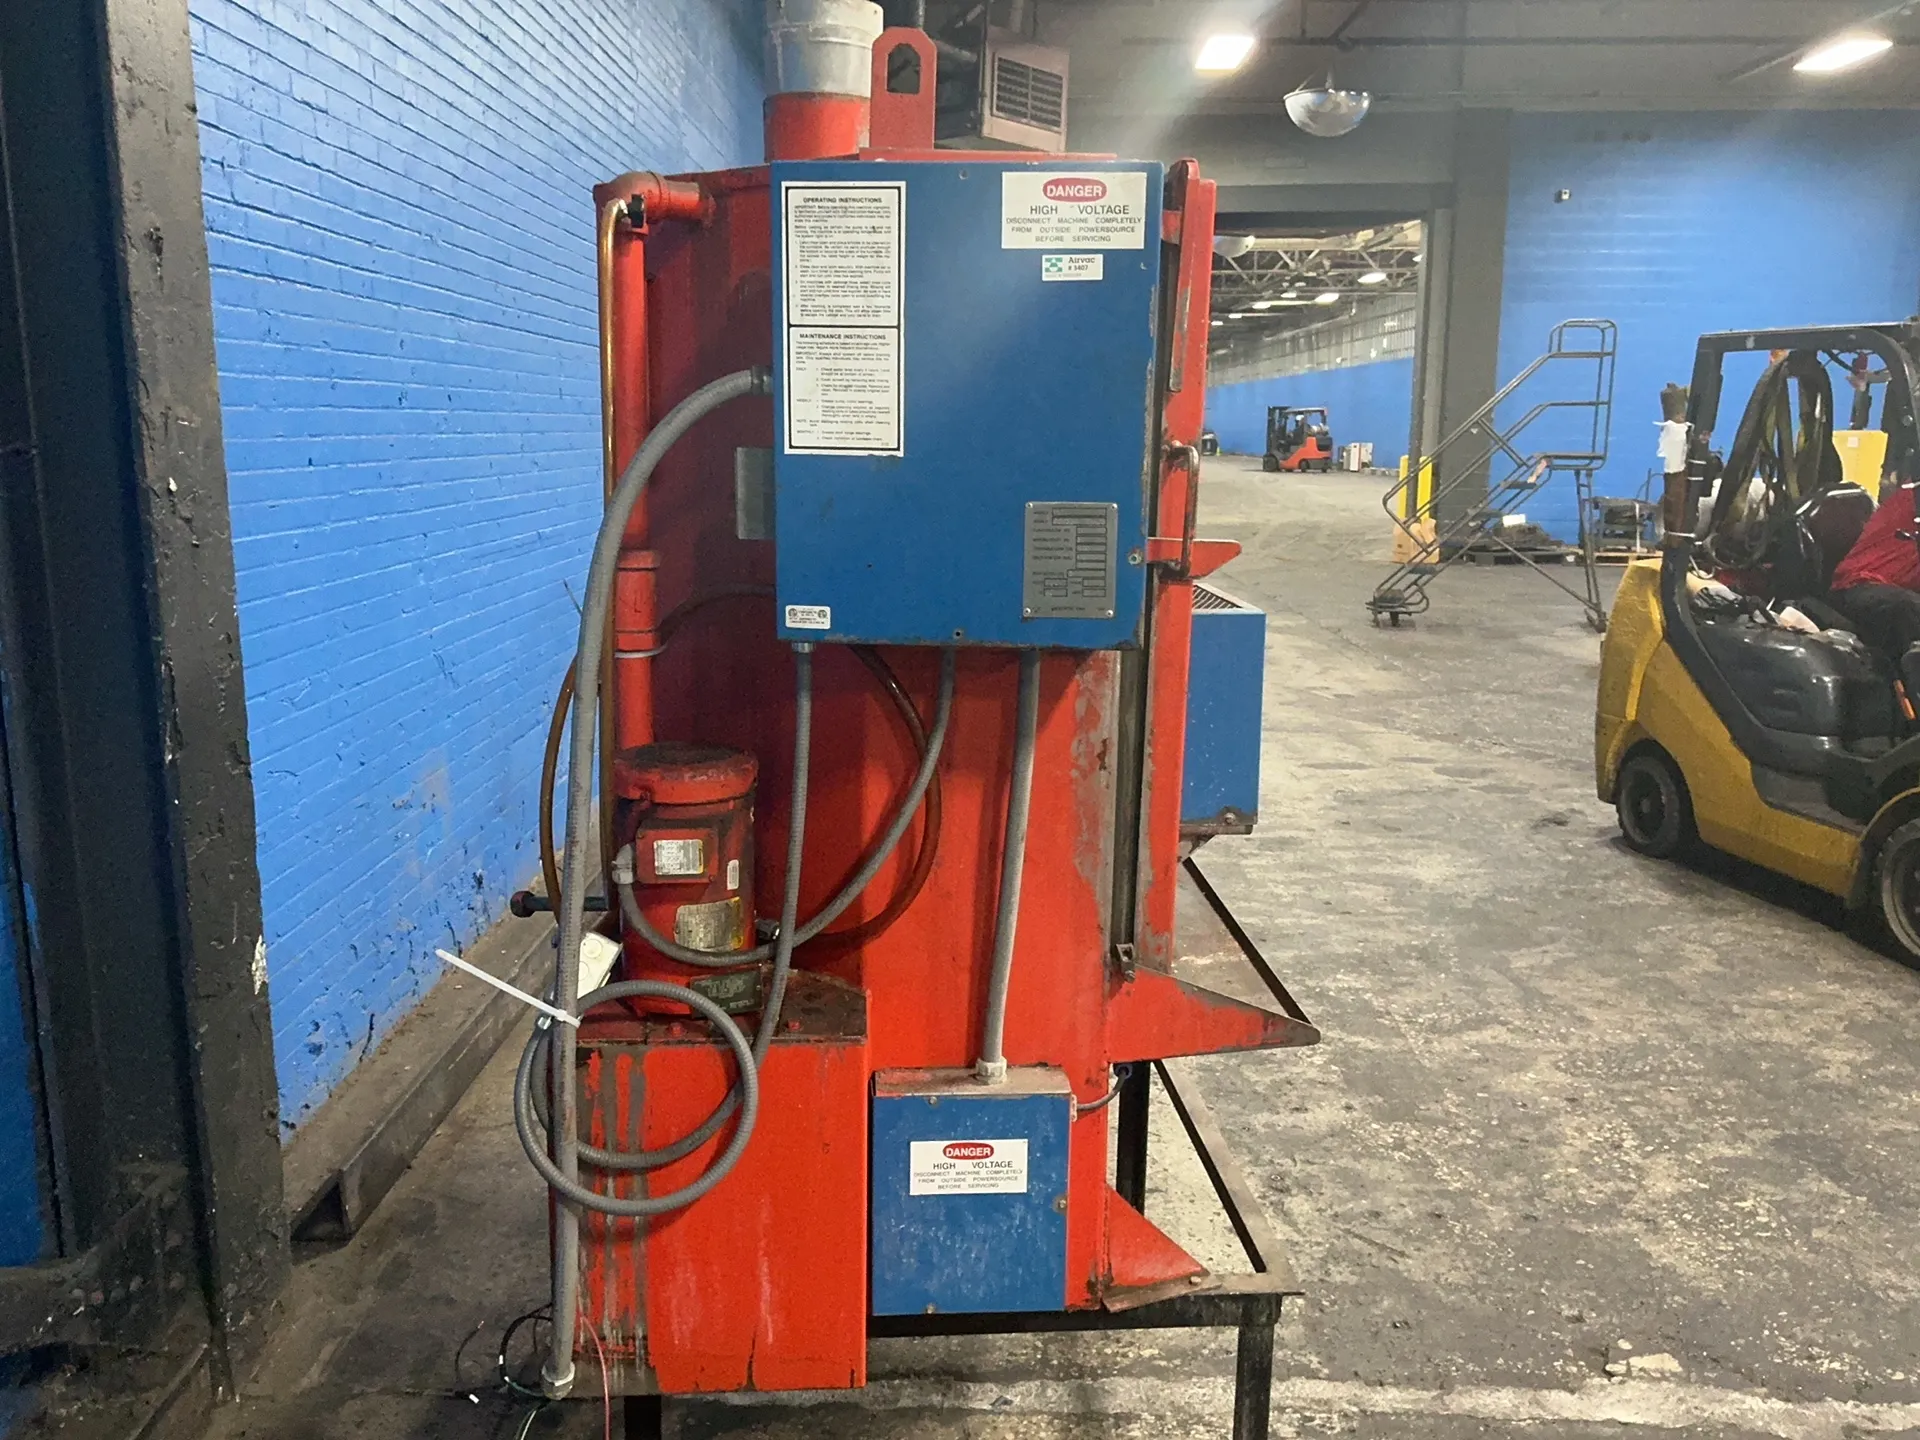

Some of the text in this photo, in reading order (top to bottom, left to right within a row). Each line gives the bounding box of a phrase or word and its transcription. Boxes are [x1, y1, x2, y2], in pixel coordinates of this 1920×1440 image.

[1046, 185, 1103, 197] DANGER
[1030, 205, 1130, 215] HIGH VOLTAGE
[945, 1147, 991, 1157] DANGER
[933, 1161, 1013, 1170] HIGH VOLTAGE
